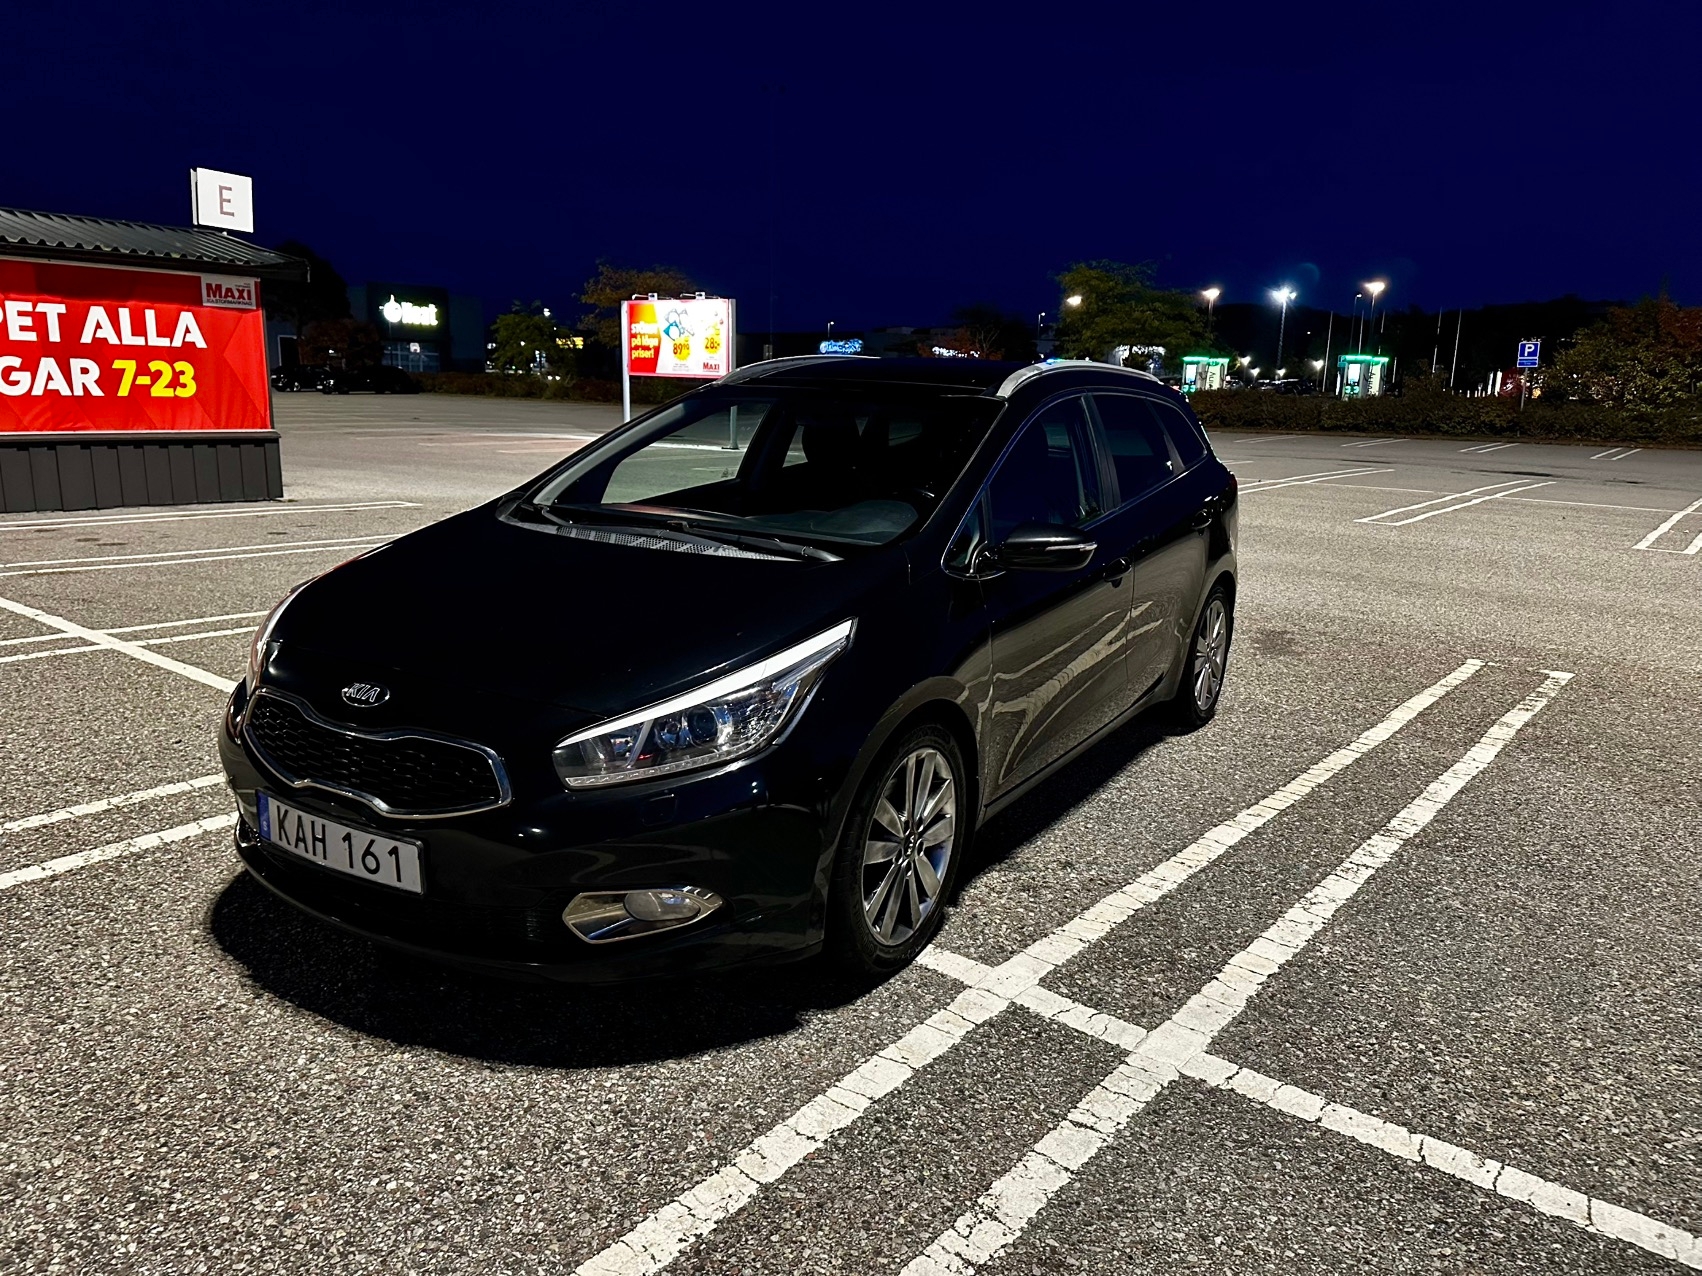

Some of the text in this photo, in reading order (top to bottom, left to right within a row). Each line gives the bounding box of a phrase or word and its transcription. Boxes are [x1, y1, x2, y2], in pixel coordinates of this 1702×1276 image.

[218, 185, 235, 217] E
[206, 283, 251, 300] MAXI
[0, 300, 208, 349] ET ALLA
[631, 334, 641, 348] på
[1524, 343, 1535, 357] P
[631, 348, 654, 360] priser!
[703, 362, 720, 370] MAXI
[0, 355, 197, 398] GAR 7-23
[346, 682, 381, 703] KIA
[276, 804, 402, 883] KAH 161
